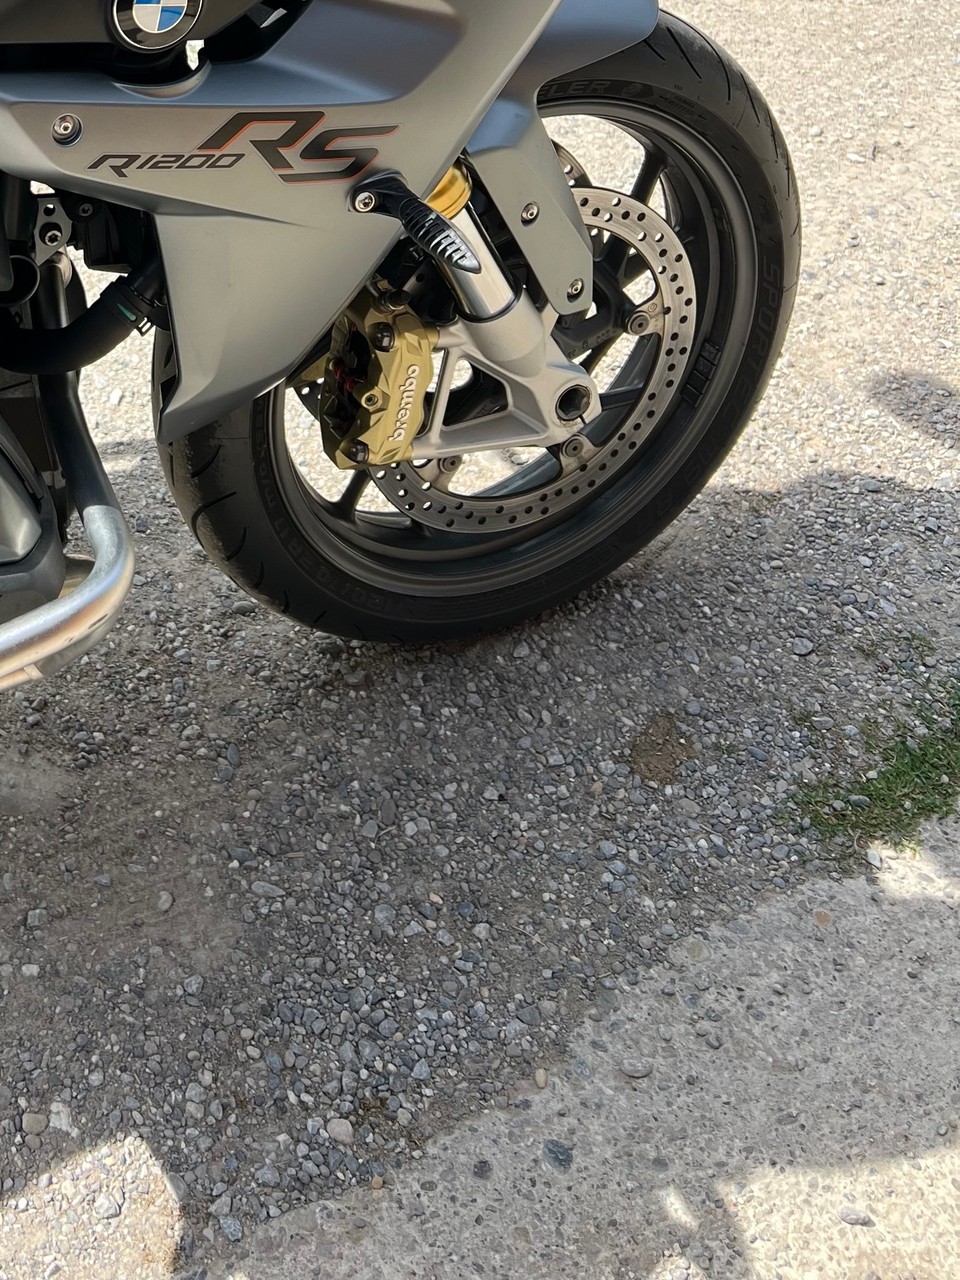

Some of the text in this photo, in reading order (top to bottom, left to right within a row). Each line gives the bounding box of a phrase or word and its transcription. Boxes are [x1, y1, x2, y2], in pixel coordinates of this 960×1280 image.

[87, 111, 400, 185] R1200 RS
[722, 255, 782, 422] SPORTEC
[387, 364, 421, 441] brembo
